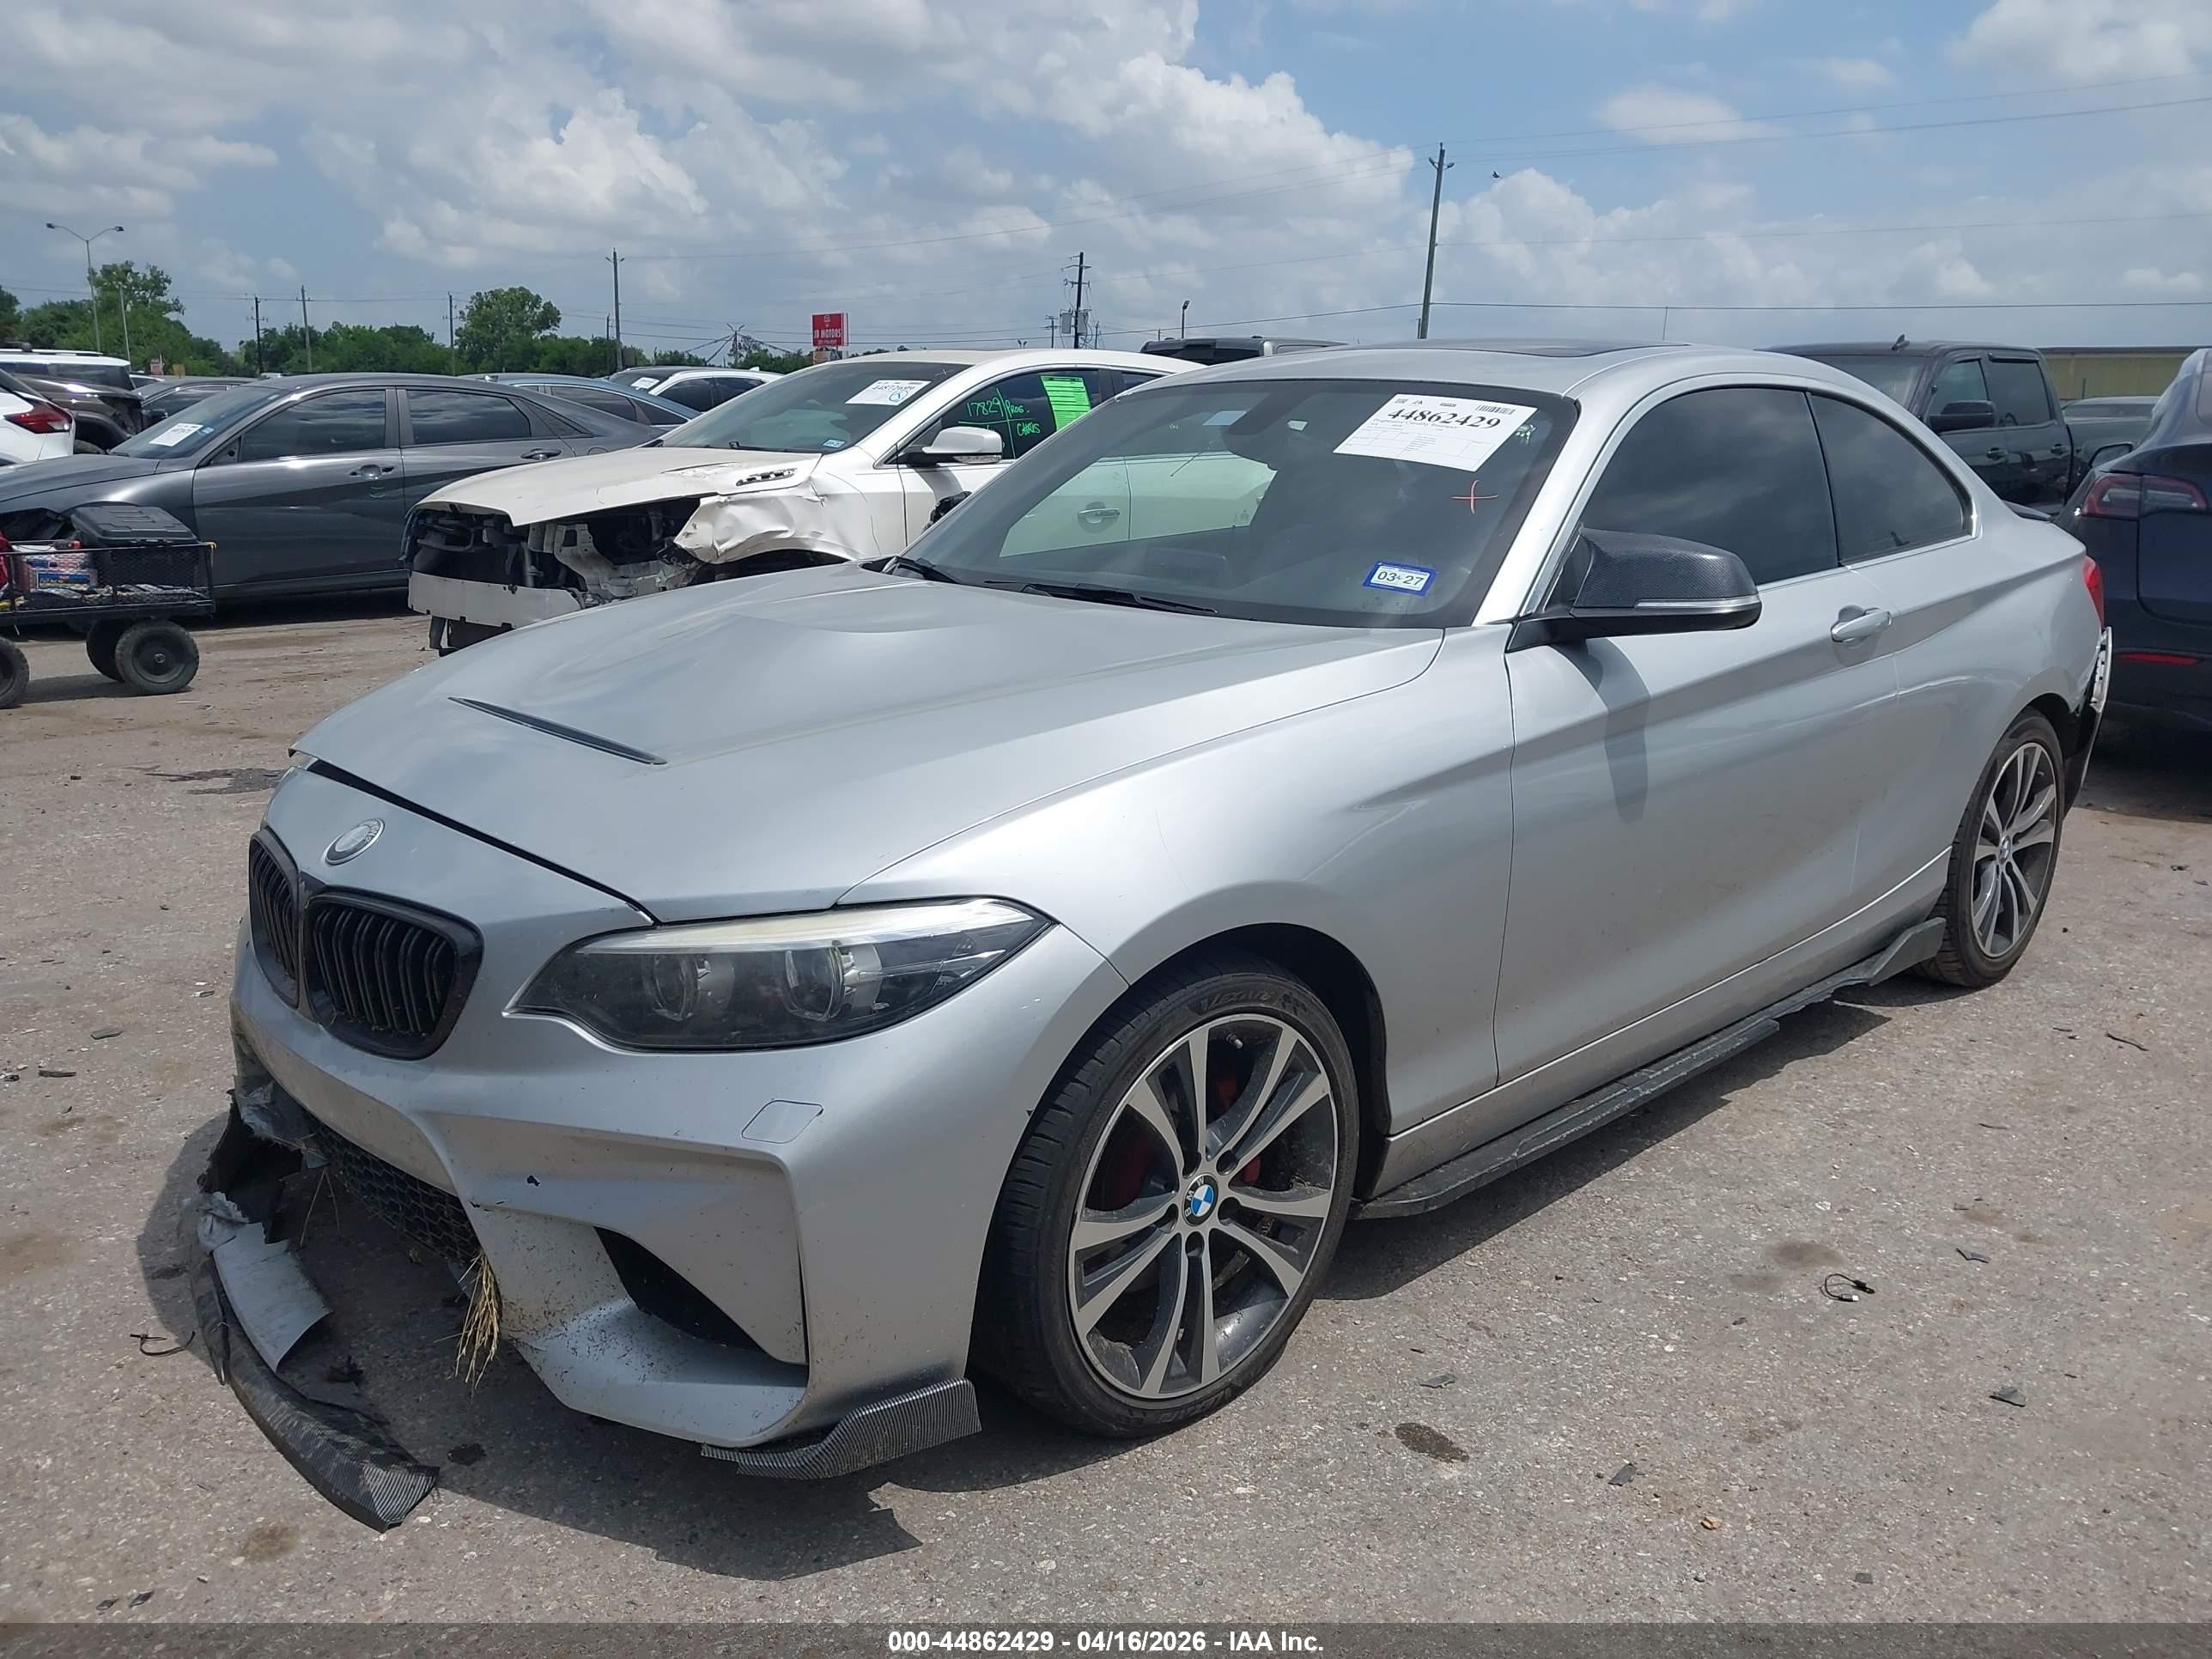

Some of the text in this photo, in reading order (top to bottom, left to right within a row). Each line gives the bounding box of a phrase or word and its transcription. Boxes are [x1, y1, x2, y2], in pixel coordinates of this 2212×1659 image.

[820, 328, 842, 338] MOTORS
[967, 398, 1004, 417] 17829
[1388, 408, 1501, 429] 44862429
[1377, 571, 1425, 586] 03 27
[1185, 1176, 1205, 1217] BMW
